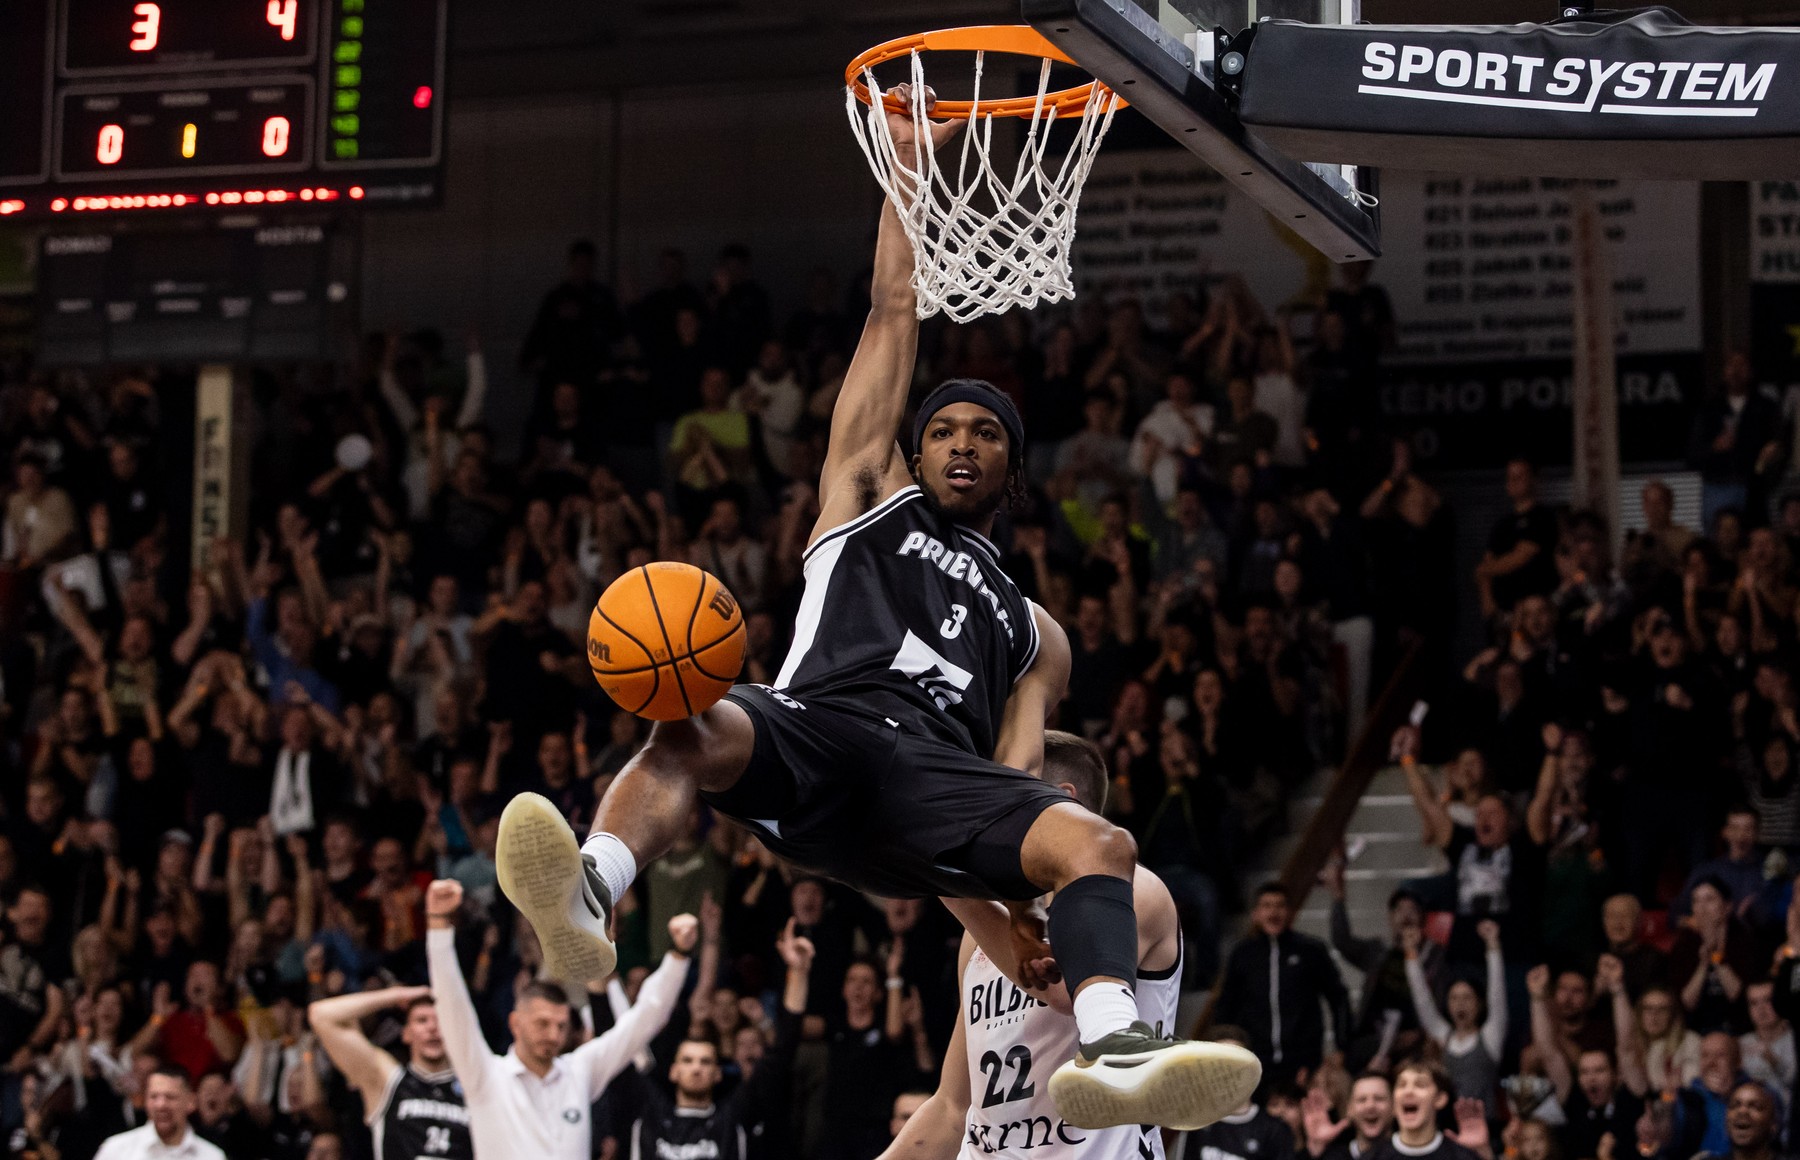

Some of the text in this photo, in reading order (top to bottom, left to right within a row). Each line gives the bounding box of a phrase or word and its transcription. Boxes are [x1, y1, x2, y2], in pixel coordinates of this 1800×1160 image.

[130, 3, 160, 51] 3
[267, 0, 297, 40] 4
[97, 124, 124, 164] 0
[181, 123, 197, 158] 1
[262, 117, 290, 156] 0
[896, 530, 1015, 650] PRIEV
[940, 603, 968, 640] 3
[970, 976, 1049, 1025] BILBA
[980, 1045, 1036, 1109] 22
